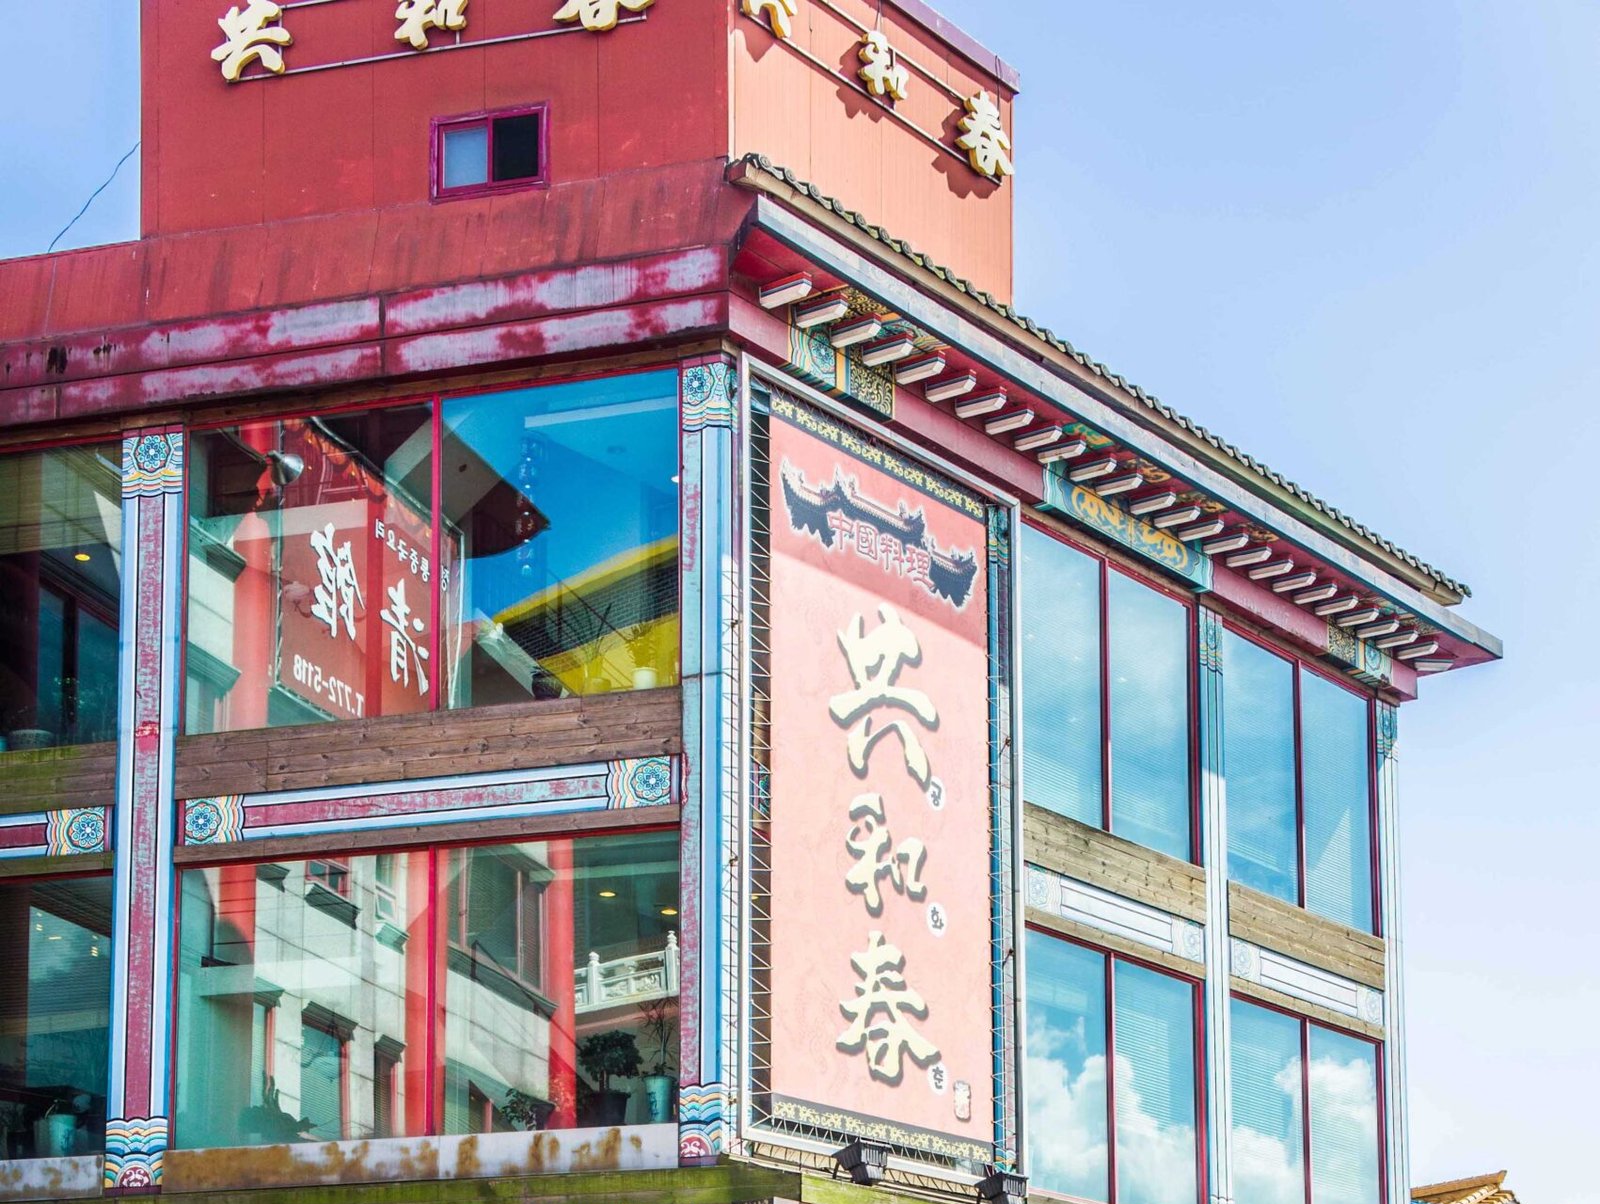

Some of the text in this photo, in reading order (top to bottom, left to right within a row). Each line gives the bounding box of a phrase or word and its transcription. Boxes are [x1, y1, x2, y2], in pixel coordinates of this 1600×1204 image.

[741, 0, 1015, 176] 和春
[827, 510, 936, 592] 中國料理
[829, 602, 940, 1087] 共和春
